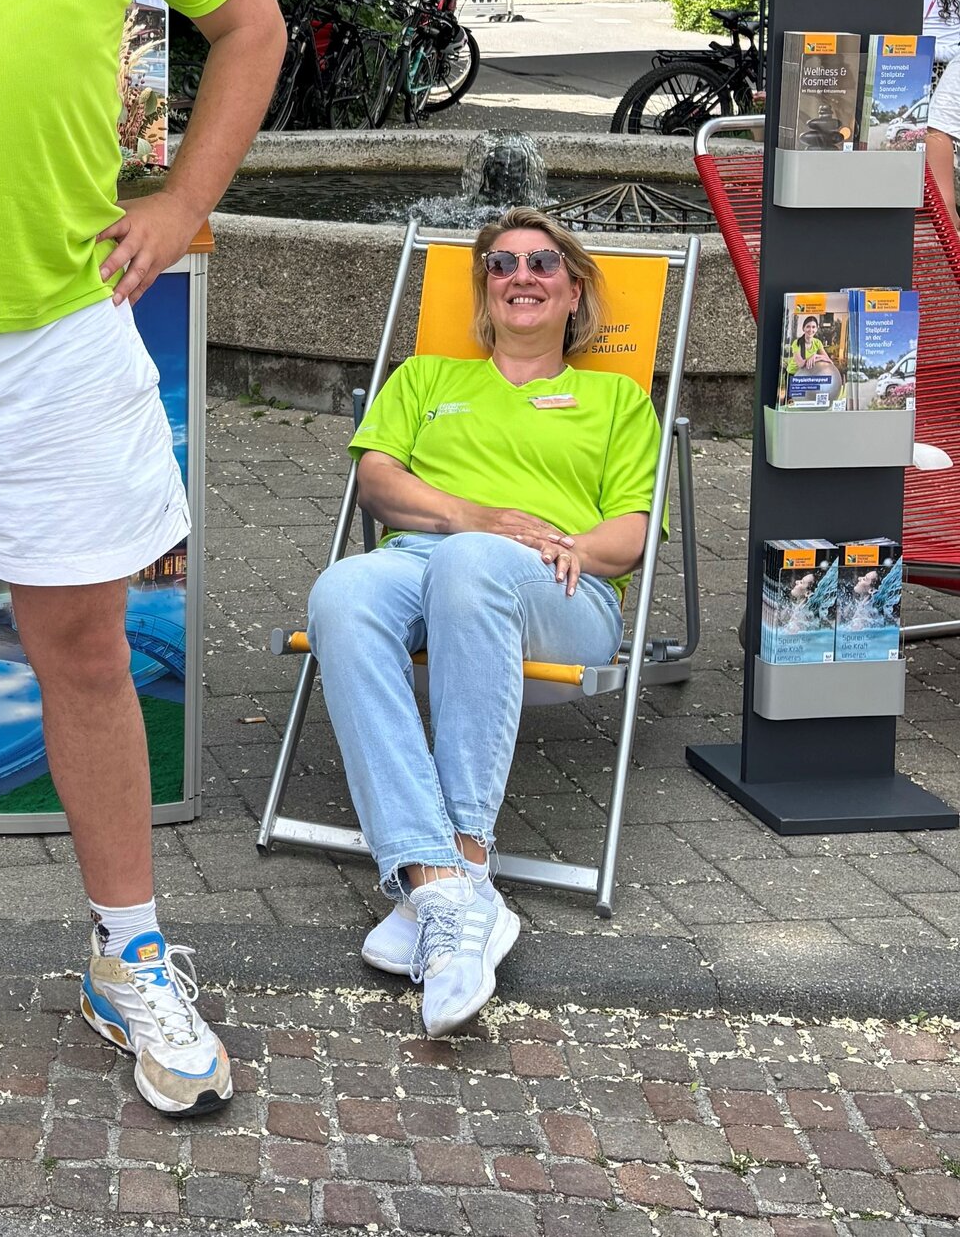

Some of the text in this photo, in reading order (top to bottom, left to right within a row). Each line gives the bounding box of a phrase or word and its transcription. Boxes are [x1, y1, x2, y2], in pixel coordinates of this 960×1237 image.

[803, 67, 847, 76] Wellness &
[802, 77, 838, 86] Kosmetik
[592, 344, 637, 353] SAULGAU
